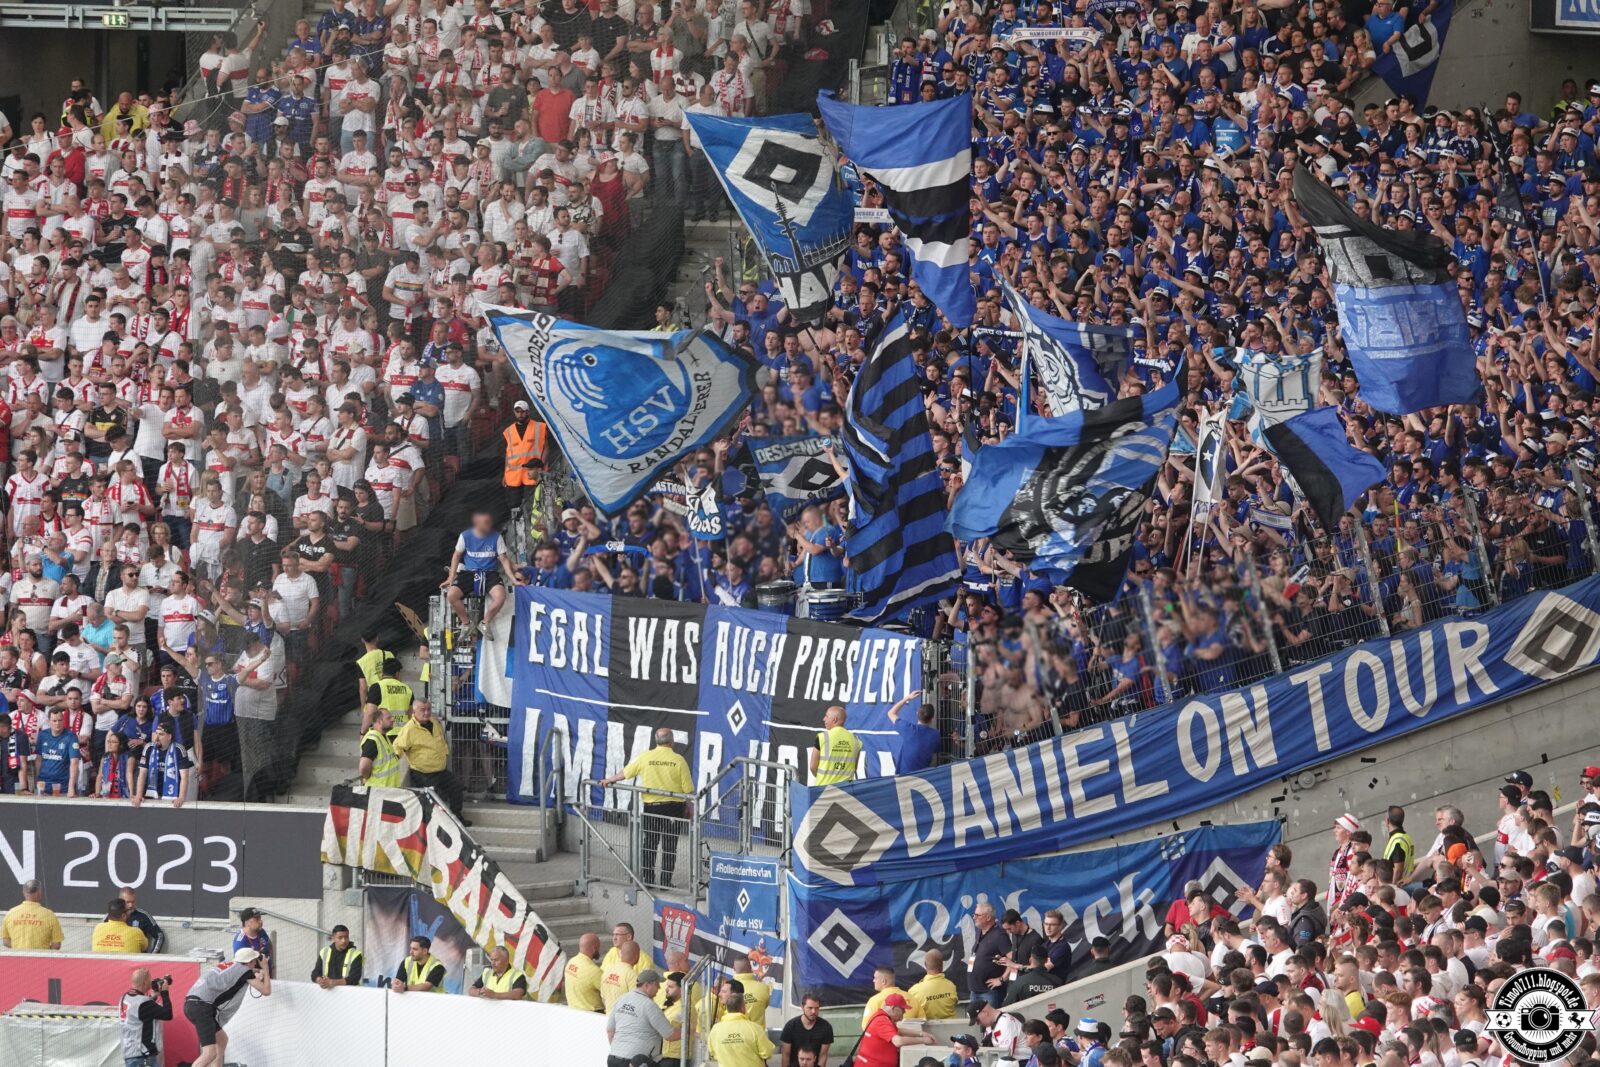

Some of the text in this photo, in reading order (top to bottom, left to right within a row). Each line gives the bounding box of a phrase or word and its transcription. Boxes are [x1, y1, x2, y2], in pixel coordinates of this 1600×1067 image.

[600, 385, 675, 454] HSV
[528, 601, 920, 704] EGAL WAS AUCH PASSIERT
[519, 707, 723, 821] IMMR
[648, 759, 678, 768] SECURITY
[895, 721, 1170, 858] DANIEL
[1176, 683, 1278, 783] ON
[1290, 621, 1500, 753] TOUR
[62, 830, 239, 894] 2023
[722, 915, 764, 930] Nur der HSV
[925, 991, 952, 1001] SECURITY
